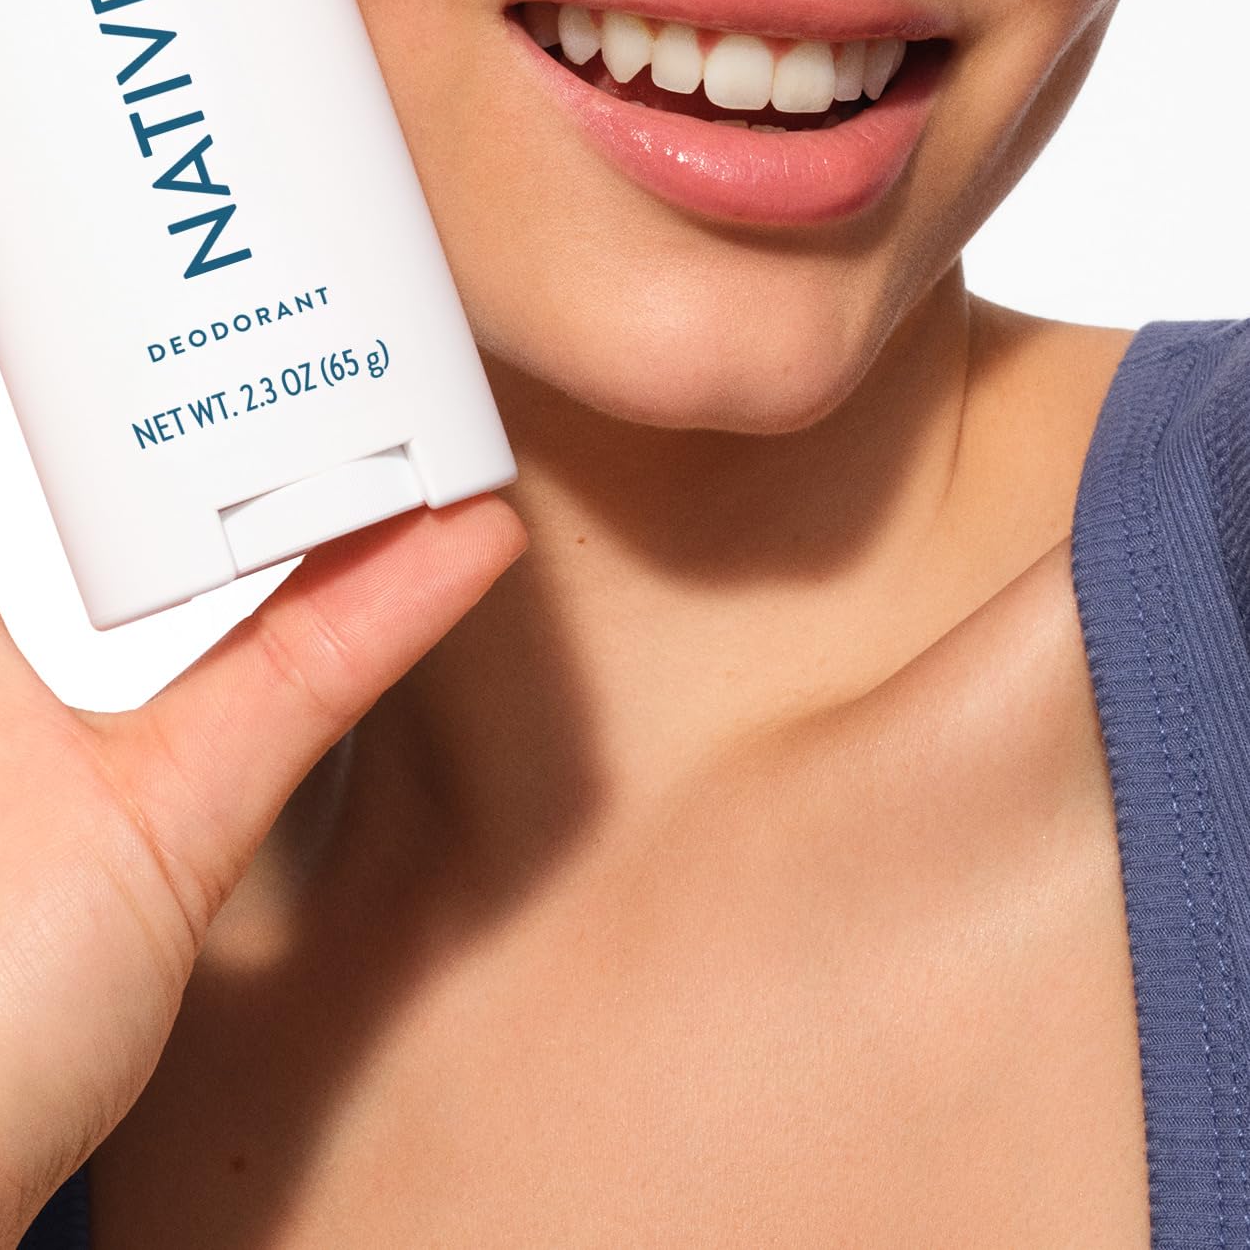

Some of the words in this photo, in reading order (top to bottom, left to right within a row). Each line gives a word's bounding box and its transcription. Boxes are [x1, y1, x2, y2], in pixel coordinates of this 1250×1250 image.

[146, 286, 331, 364] DEODORANT
[131, 406, 187, 450] NET
[187, 391, 240, 428] WT.
[240, 376, 278, 413] 2.3
[281, 361, 318, 397] OZ
[320, 349, 360, 387] (65
[366, 339, 390, 379] g)
